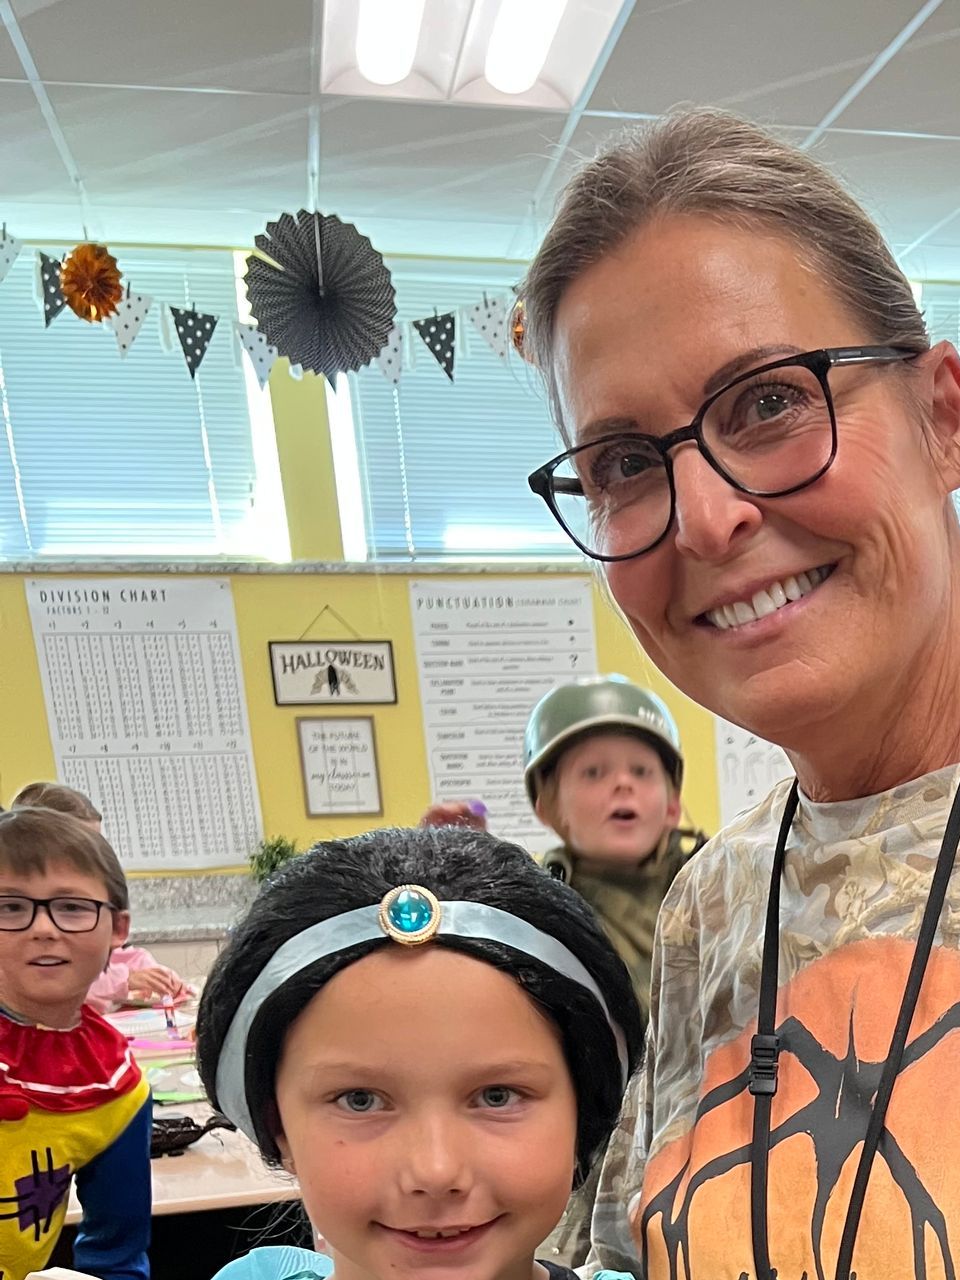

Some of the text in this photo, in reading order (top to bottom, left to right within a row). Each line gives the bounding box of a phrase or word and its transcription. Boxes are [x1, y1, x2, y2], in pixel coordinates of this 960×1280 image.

[40, 589, 166, 603] DIVISION CHART
[417, 596, 514, 610] PUNCTUATION
[47, 605, 82, 616] FACTORS
[281, 648, 385, 675] HALLOWEEN
